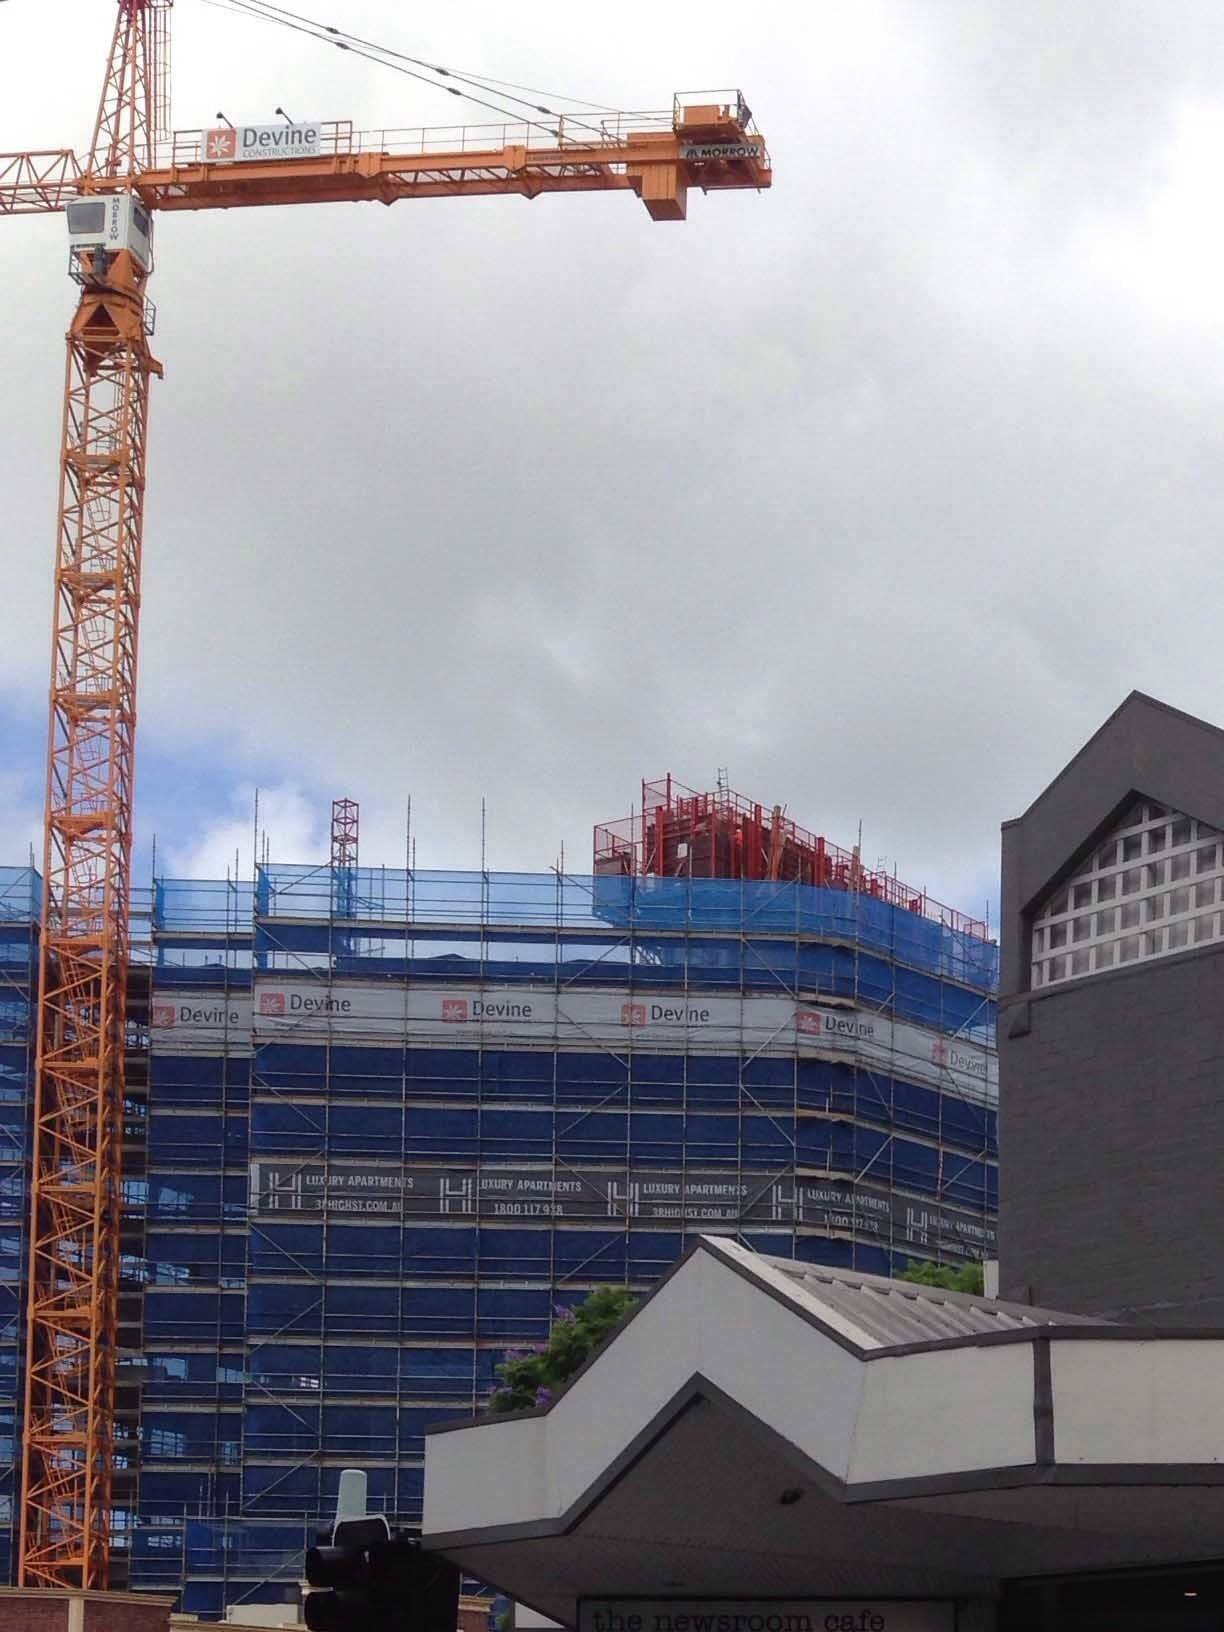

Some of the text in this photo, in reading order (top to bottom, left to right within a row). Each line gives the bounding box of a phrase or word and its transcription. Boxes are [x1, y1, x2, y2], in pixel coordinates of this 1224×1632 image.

[243, 125, 317, 148] Devine
[243, 145, 316, 158] CONSTRUCTIONS
[701, 146, 759, 158] MORROW
[290, 993, 351, 1012] Devine
[473, 1000, 532, 1018] Devine
[651, 1005, 709, 1022] Devine
[825, 1015, 874, 1037] Devine
[643, 1183, 681, 1195] LUXURY
[807, 1187, 842, 1202] LUXURY
[592, 1609, 885, 1632] the newsroom cafe
